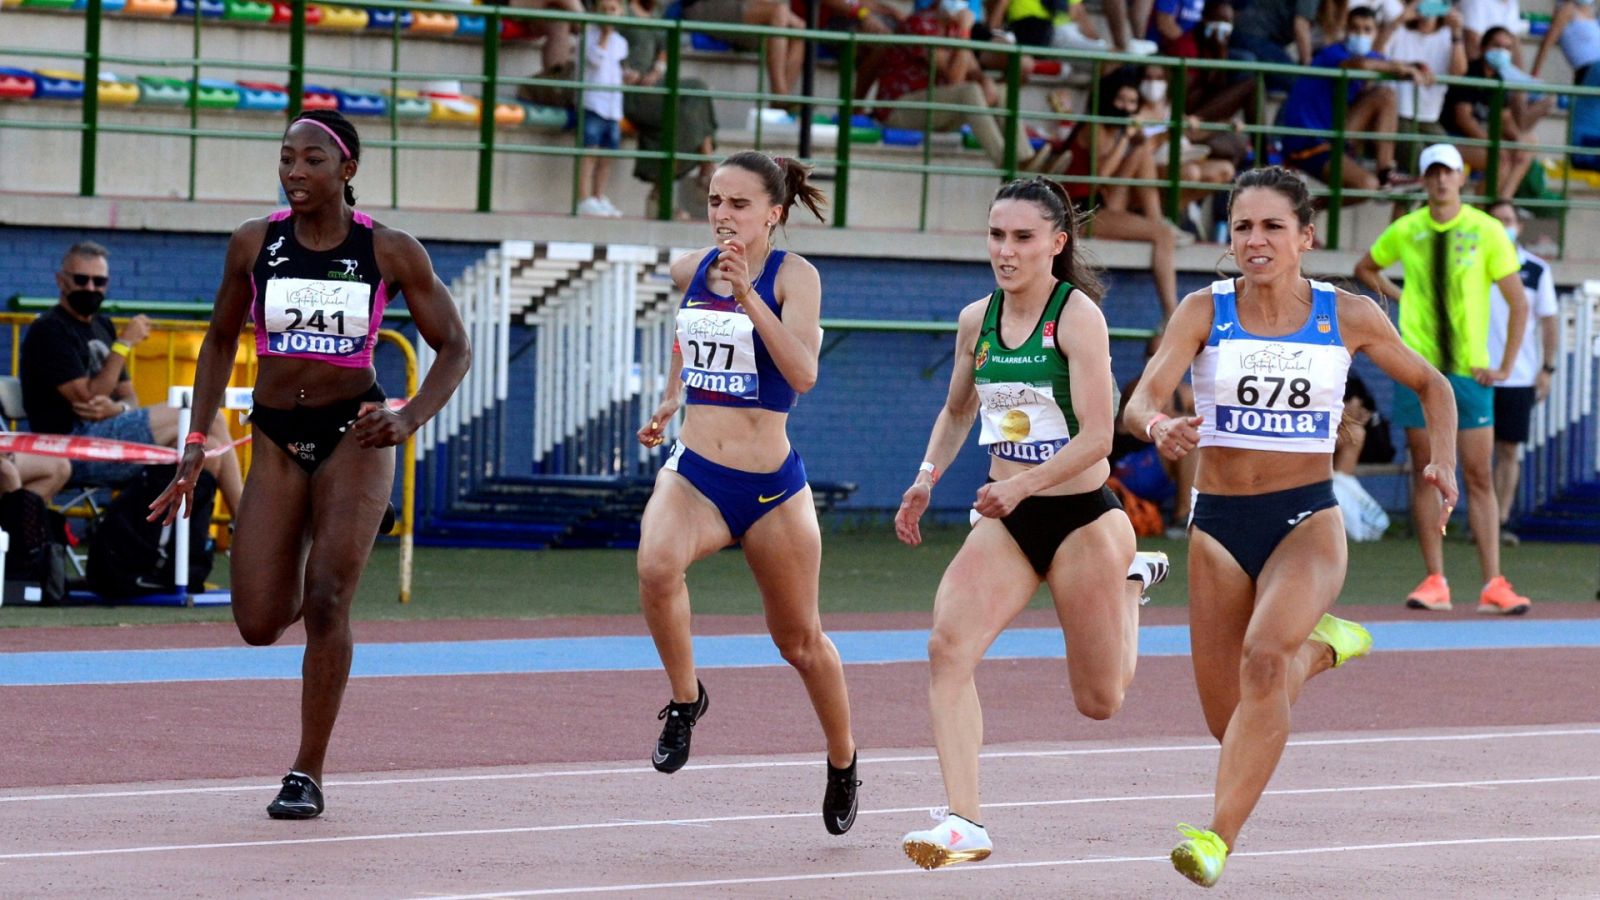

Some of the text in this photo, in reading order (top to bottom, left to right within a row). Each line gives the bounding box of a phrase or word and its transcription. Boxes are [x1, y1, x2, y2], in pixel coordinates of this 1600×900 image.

[285, 308, 345, 335] 241
[688, 340, 735, 370] 277
[992, 355, 1032, 364] VILLARREAL
[1237, 375, 1311, 409] 678
